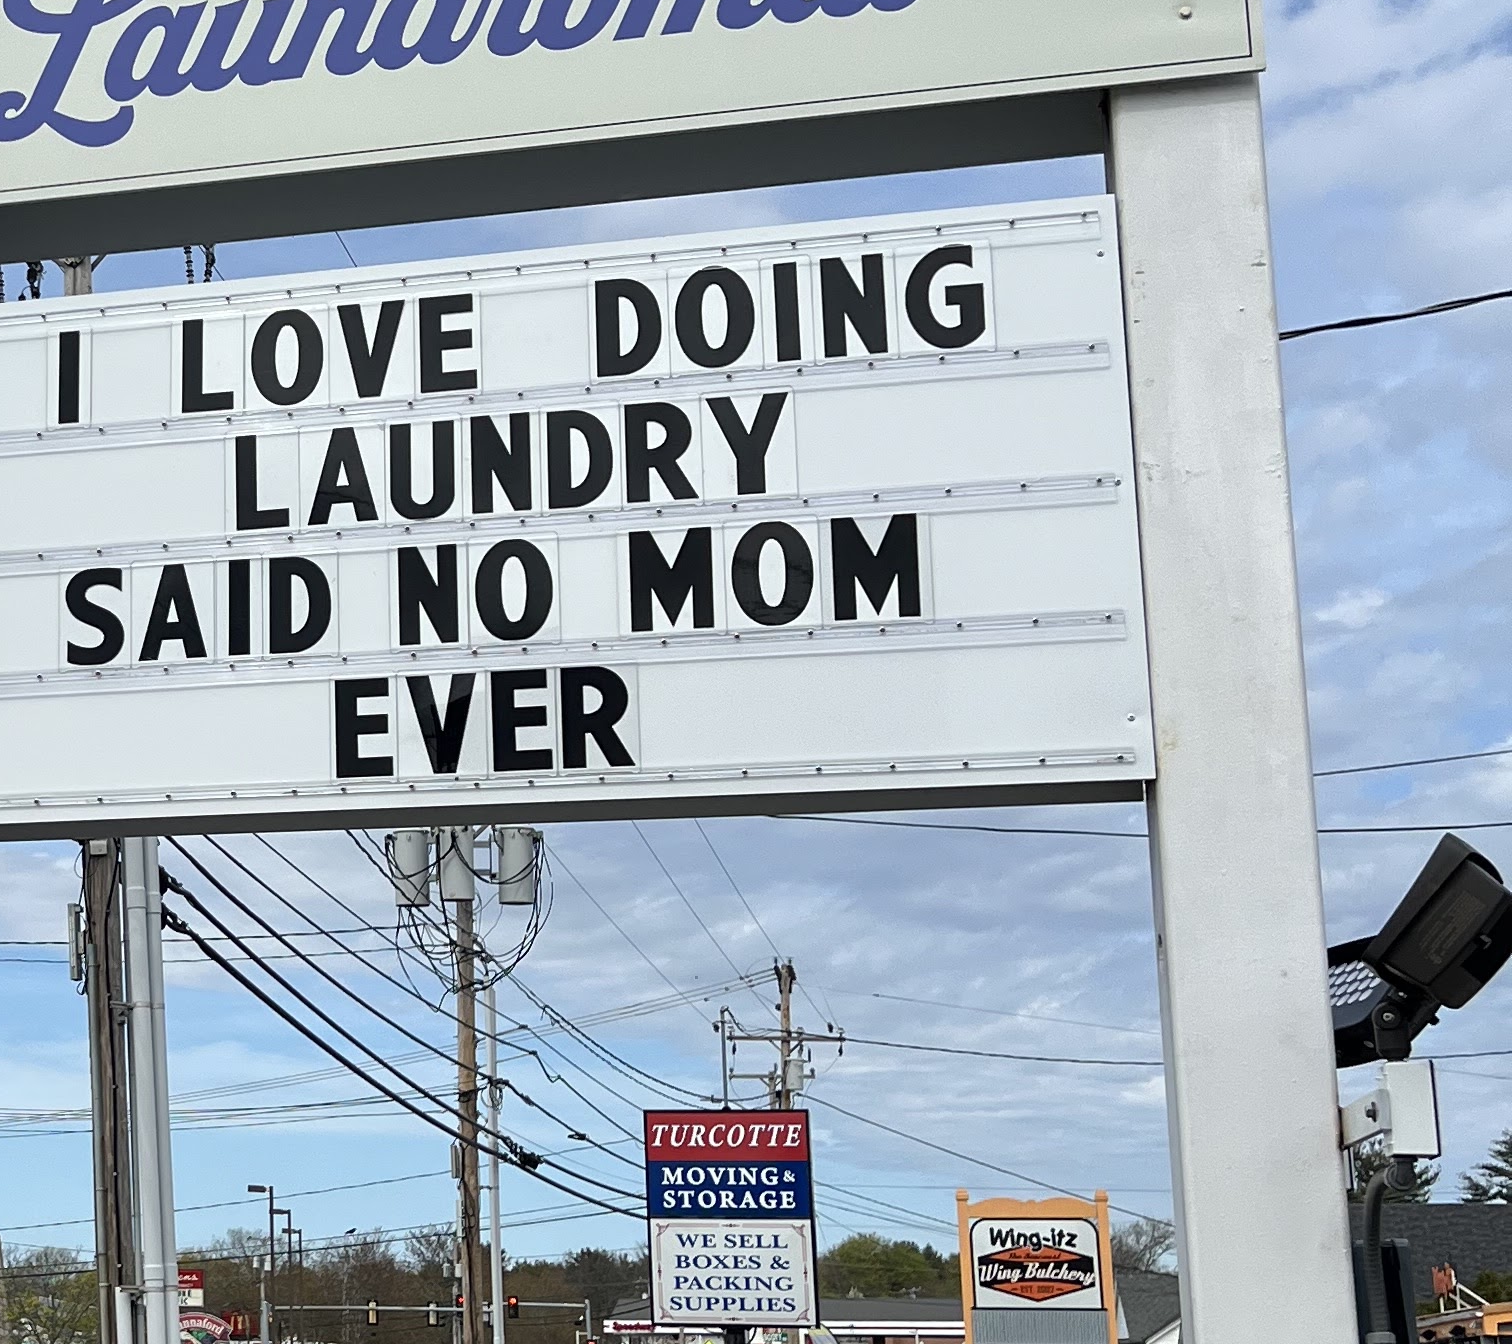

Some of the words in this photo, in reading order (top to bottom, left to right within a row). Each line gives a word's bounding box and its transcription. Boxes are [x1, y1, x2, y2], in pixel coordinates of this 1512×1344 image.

[58, 330, 81, 426] I
[180, 292, 480, 415] LOVE
[595, 243, 988, 379] DOING
[234, 391, 789, 531] LAUNDRY
[64, 555, 332, 667] SAID
[396, 537, 555, 648] NO
[628, 512, 923, 633] MOM
[333, 664, 636, 780] EVER
[651, 1123, 802, 1148] TURCOTTE
[661, 1167, 779, 1186] MOVING
[782, 1169, 796, 1183] &
[662, 1189, 797, 1209] STORAGE
[675, 1233, 717, 1248] WE
[724, 1233, 789, 1249] SELL
[989, 1226, 1079, 1252] Wing-itz
[675, 1254, 762, 1270] BOXES
[769, 1255, 790, 1270] &
[673, 1275, 795, 1292] PACKING
[978, 1263, 1023, 1284] Wing
[669, 1296, 797, 1313] SUPPLIES
